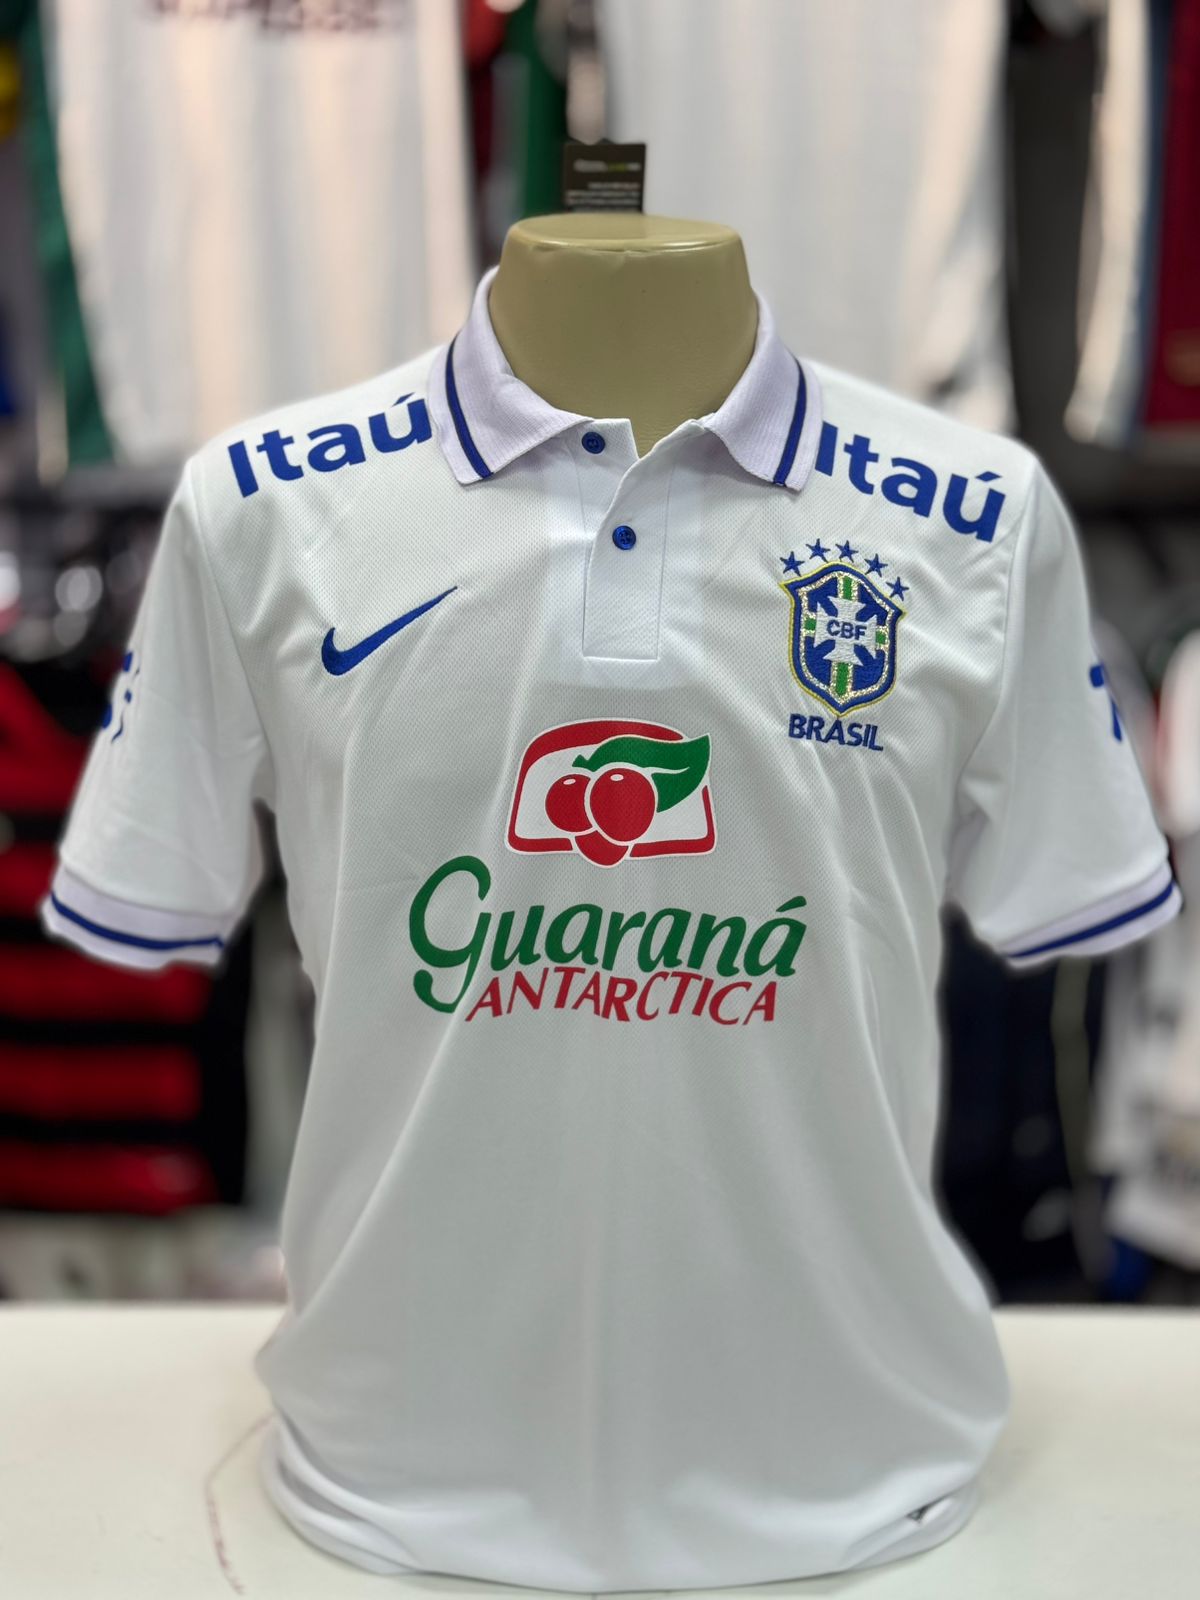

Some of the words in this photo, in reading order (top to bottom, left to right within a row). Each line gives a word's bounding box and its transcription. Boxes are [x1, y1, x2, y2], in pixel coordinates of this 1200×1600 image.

[227, 392, 433, 498] Itaú
[814, 420, 1006, 543] Itaú
[826, 619, 868, 641] CBF
[788, 713, 884, 751] BRASIL
[409, 855, 808, 1014] Guaraná
[465, 966, 778, 1026] ANTARCTICA
